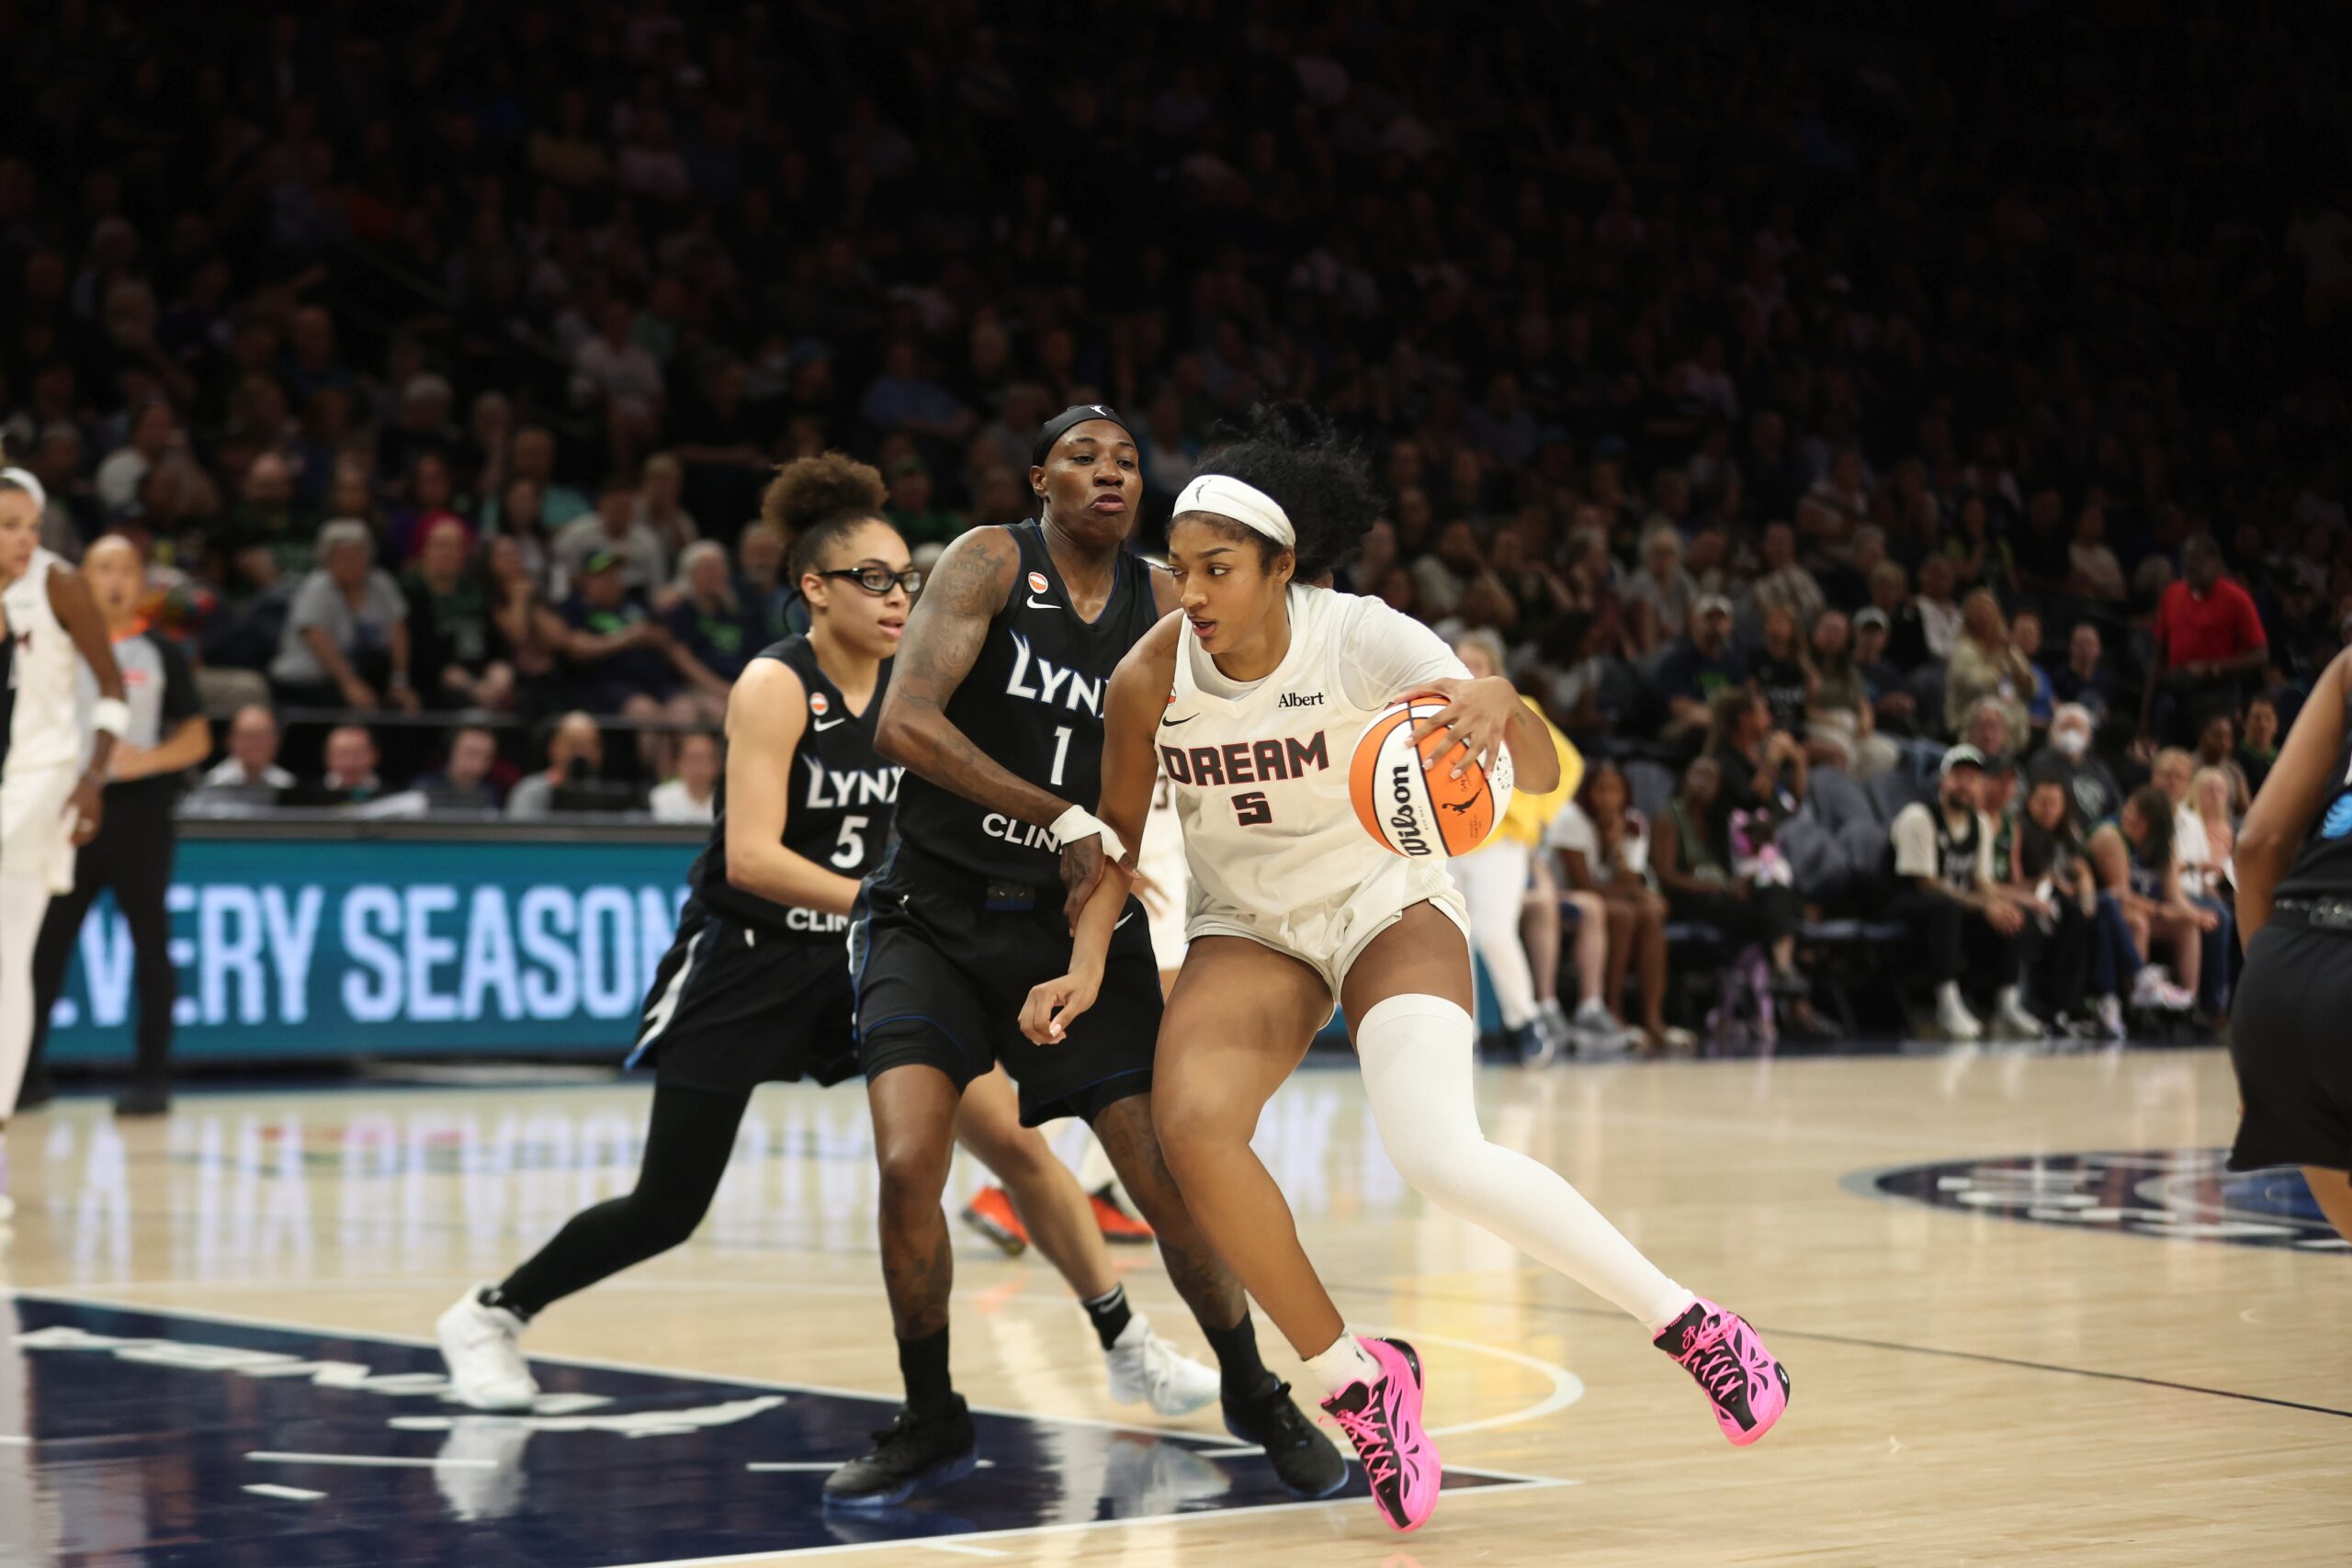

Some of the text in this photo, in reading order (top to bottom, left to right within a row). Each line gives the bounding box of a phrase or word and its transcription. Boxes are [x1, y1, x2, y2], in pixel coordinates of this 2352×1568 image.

[1277, 692, 1325, 708] Albert
[1049, 726, 1073, 786] 1
[1159, 730, 1329, 787] DREAM
[982, 812, 1063, 855] CLIN
[1231, 791, 1272, 827] 5
[1391, 763, 1431, 856] Wilson
[830, 815, 869, 869] 5
[49, 885, 323, 1028] VERY
